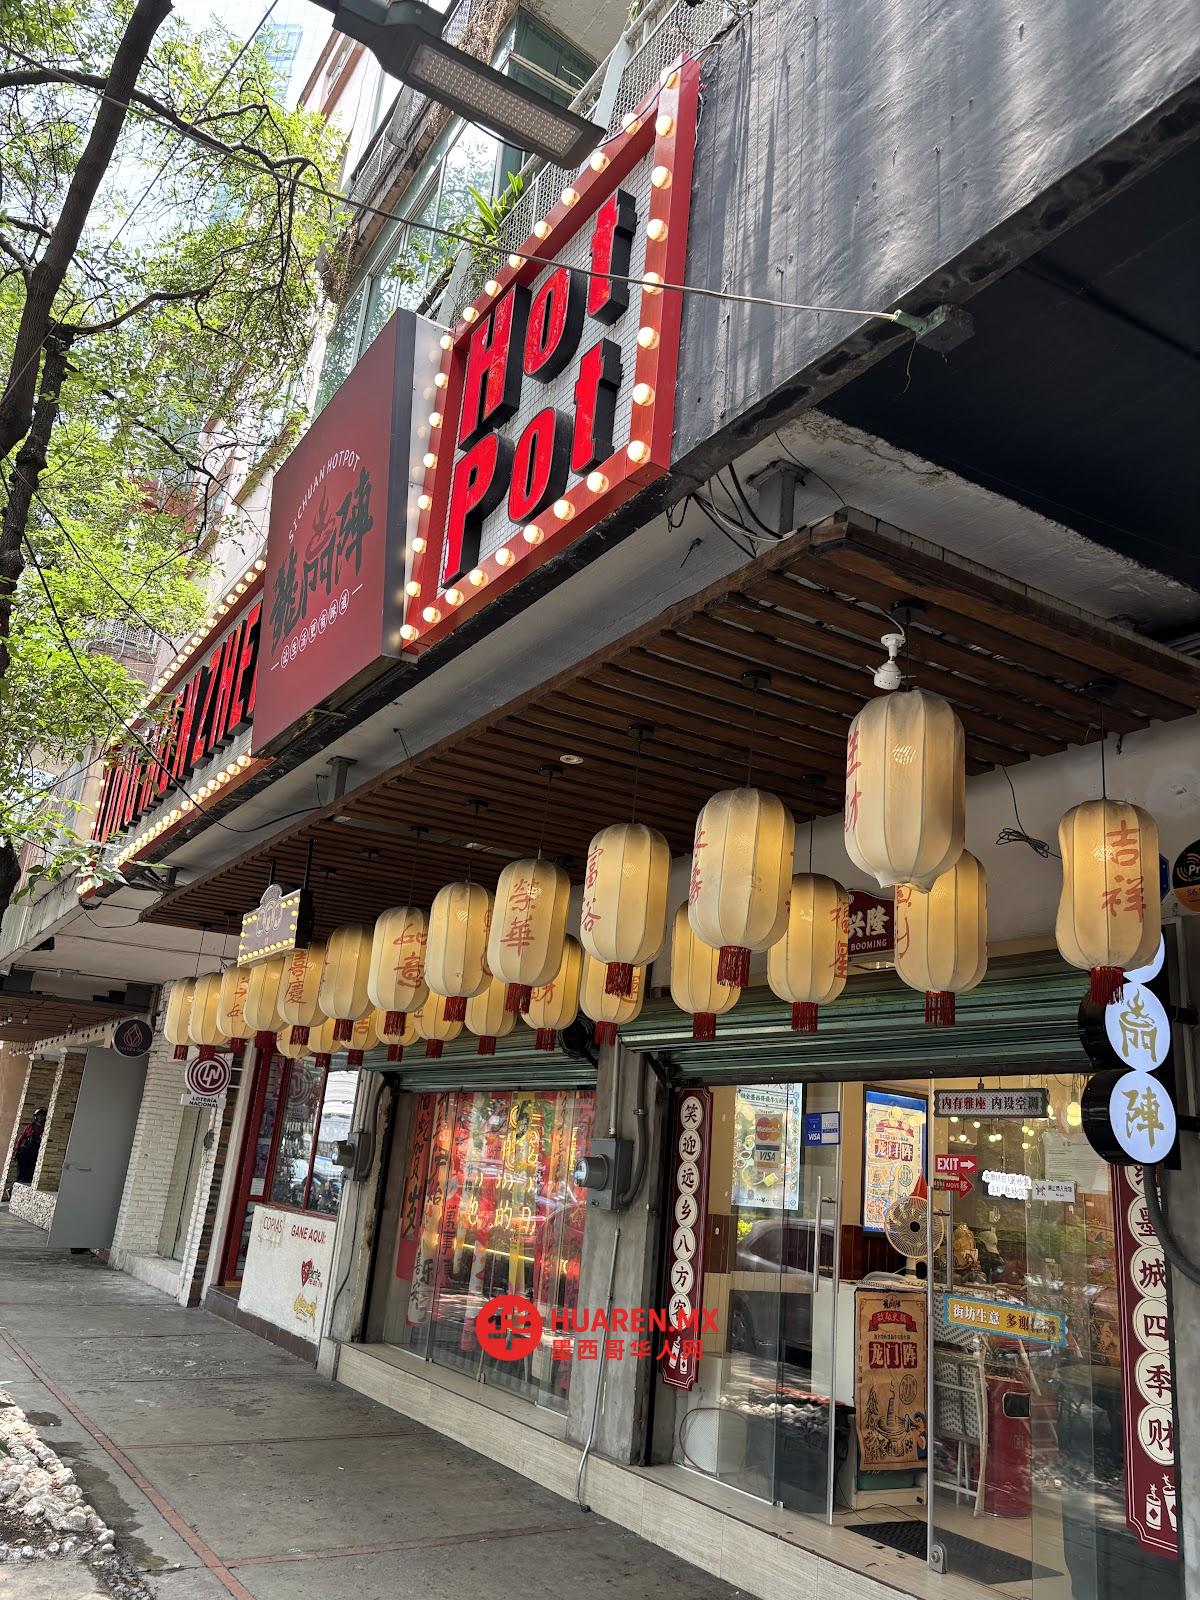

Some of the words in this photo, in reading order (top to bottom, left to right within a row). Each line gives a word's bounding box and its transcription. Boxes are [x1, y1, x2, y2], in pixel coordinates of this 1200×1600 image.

[288, 464, 326, 545] SICHUAN
[326, 449, 361, 475] HOTPOT
[1101, 819, 1147, 924] 吉祥
[850, 938, 888, 951] BOOMING
[941, 1096, 987, 1111] 内有雅座
[807, 1132, 821, 1141] VISA
[760, 1151, 776, 1161] VISA
[937, 1157, 959, 1171] EXIT
[291, 1224, 307, 1240] GANE
[953, 1304, 1000, 1325] 街坊生意
[869, 1342, 918, 1368] 龙门阵
